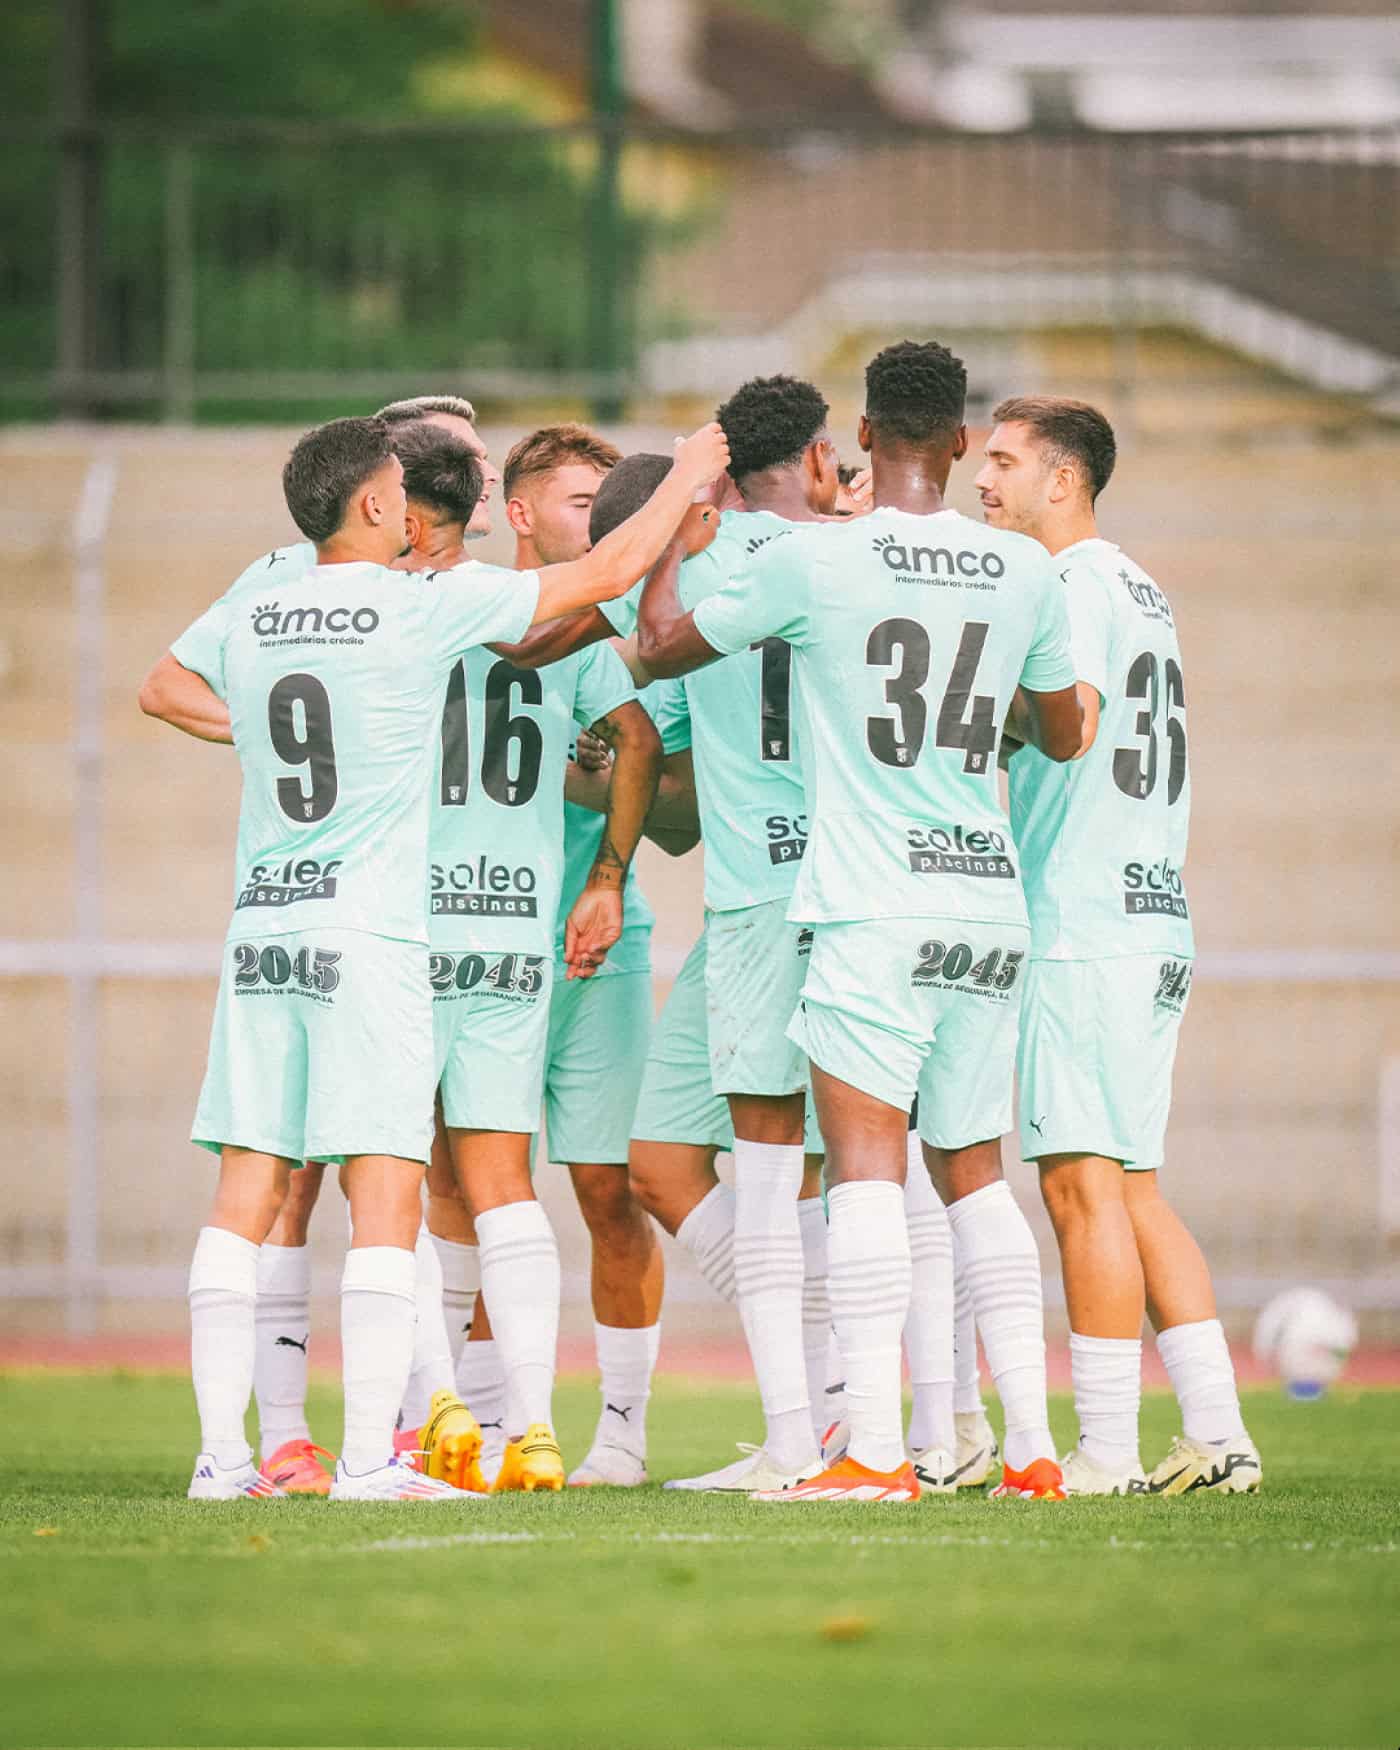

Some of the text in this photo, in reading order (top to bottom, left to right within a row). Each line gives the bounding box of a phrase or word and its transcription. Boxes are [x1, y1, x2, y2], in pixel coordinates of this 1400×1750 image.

[882, 544, 1005, 578] amco
[253, 605, 380, 636] amco
[866, 616, 998, 775] 34
[267, 671, 339, 824] 9
[440, 656, 544, 807] 16
[431, 855, 537, 893] soleo
[432, 894, 530, 913] piscinas
[234, 944, 342, 994] 2045
[429, 953, 545, 995] 2045
[911, 940, 1025, 990] 2045
